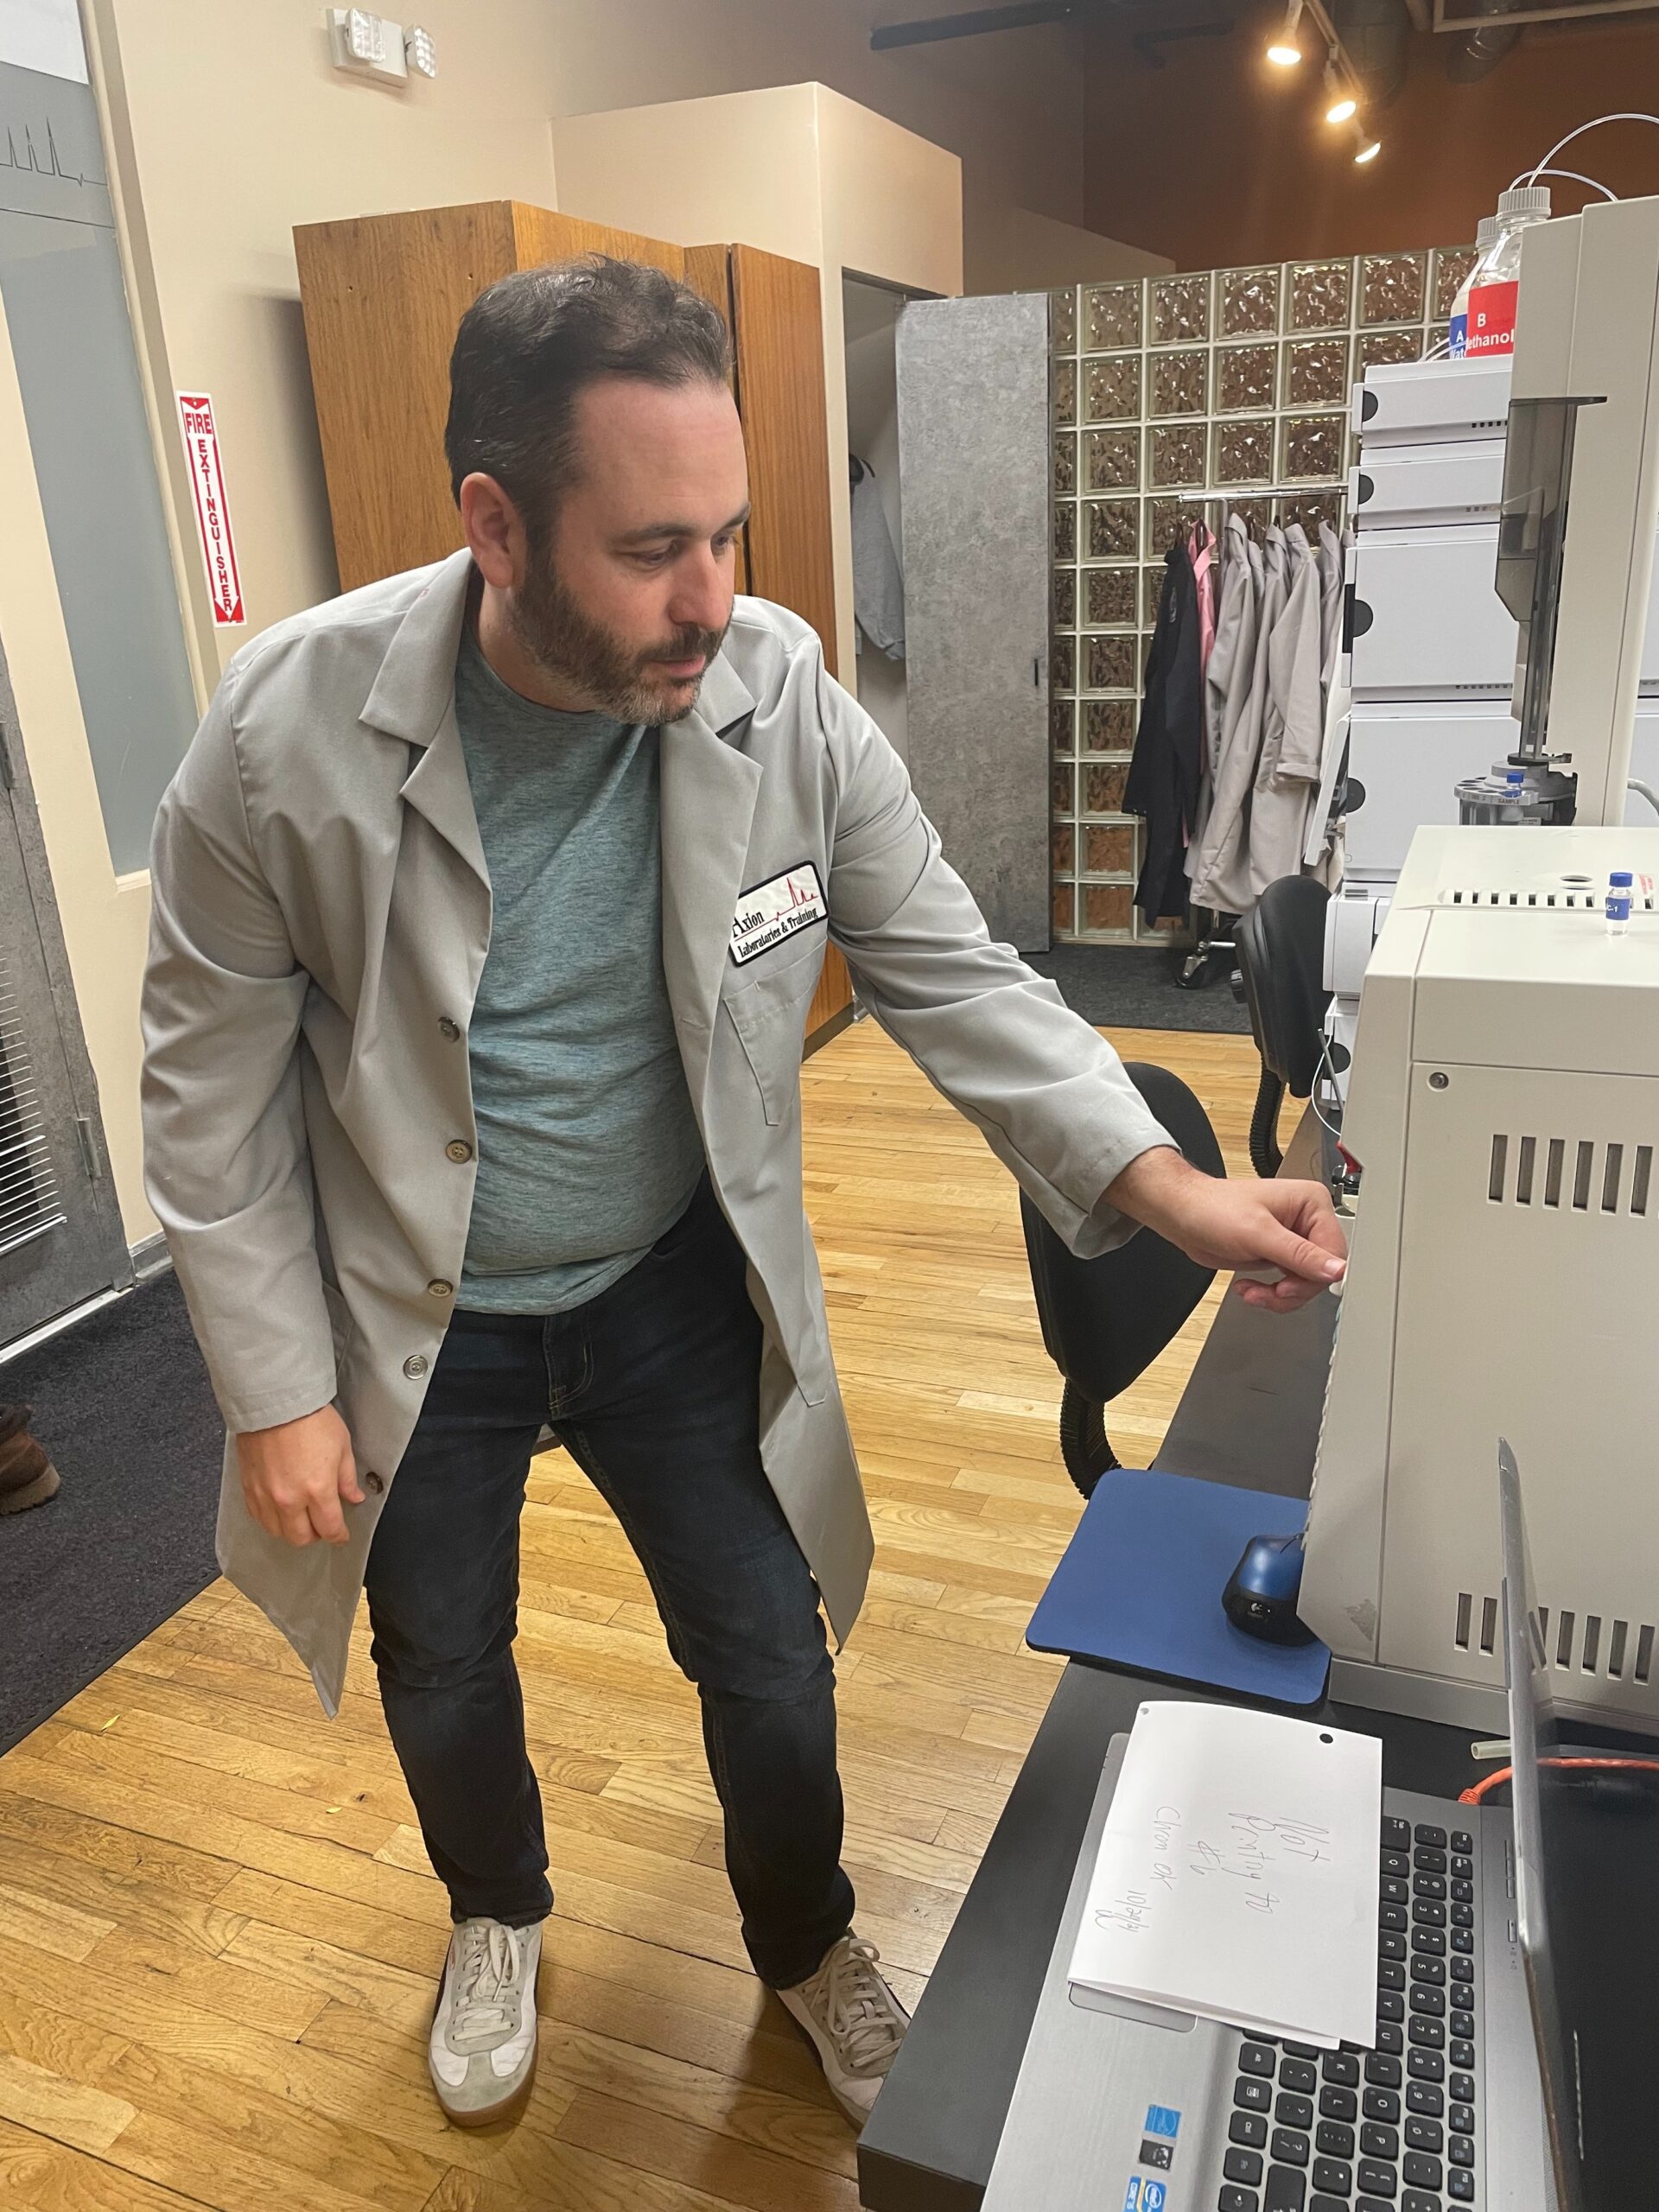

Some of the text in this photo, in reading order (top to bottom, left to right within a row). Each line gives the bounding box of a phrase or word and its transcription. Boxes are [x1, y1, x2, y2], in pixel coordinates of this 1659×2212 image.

[1477, 313, 1486, 327] B
[1456, 330, 1464, 343] A
[185, 413, 213, 434] FIRE
[198, 439, 232, 611] EXTINGUISHER
[732, 912, 765, 938] Axion
[738, 908, 818, 957] Laboratories & Training
